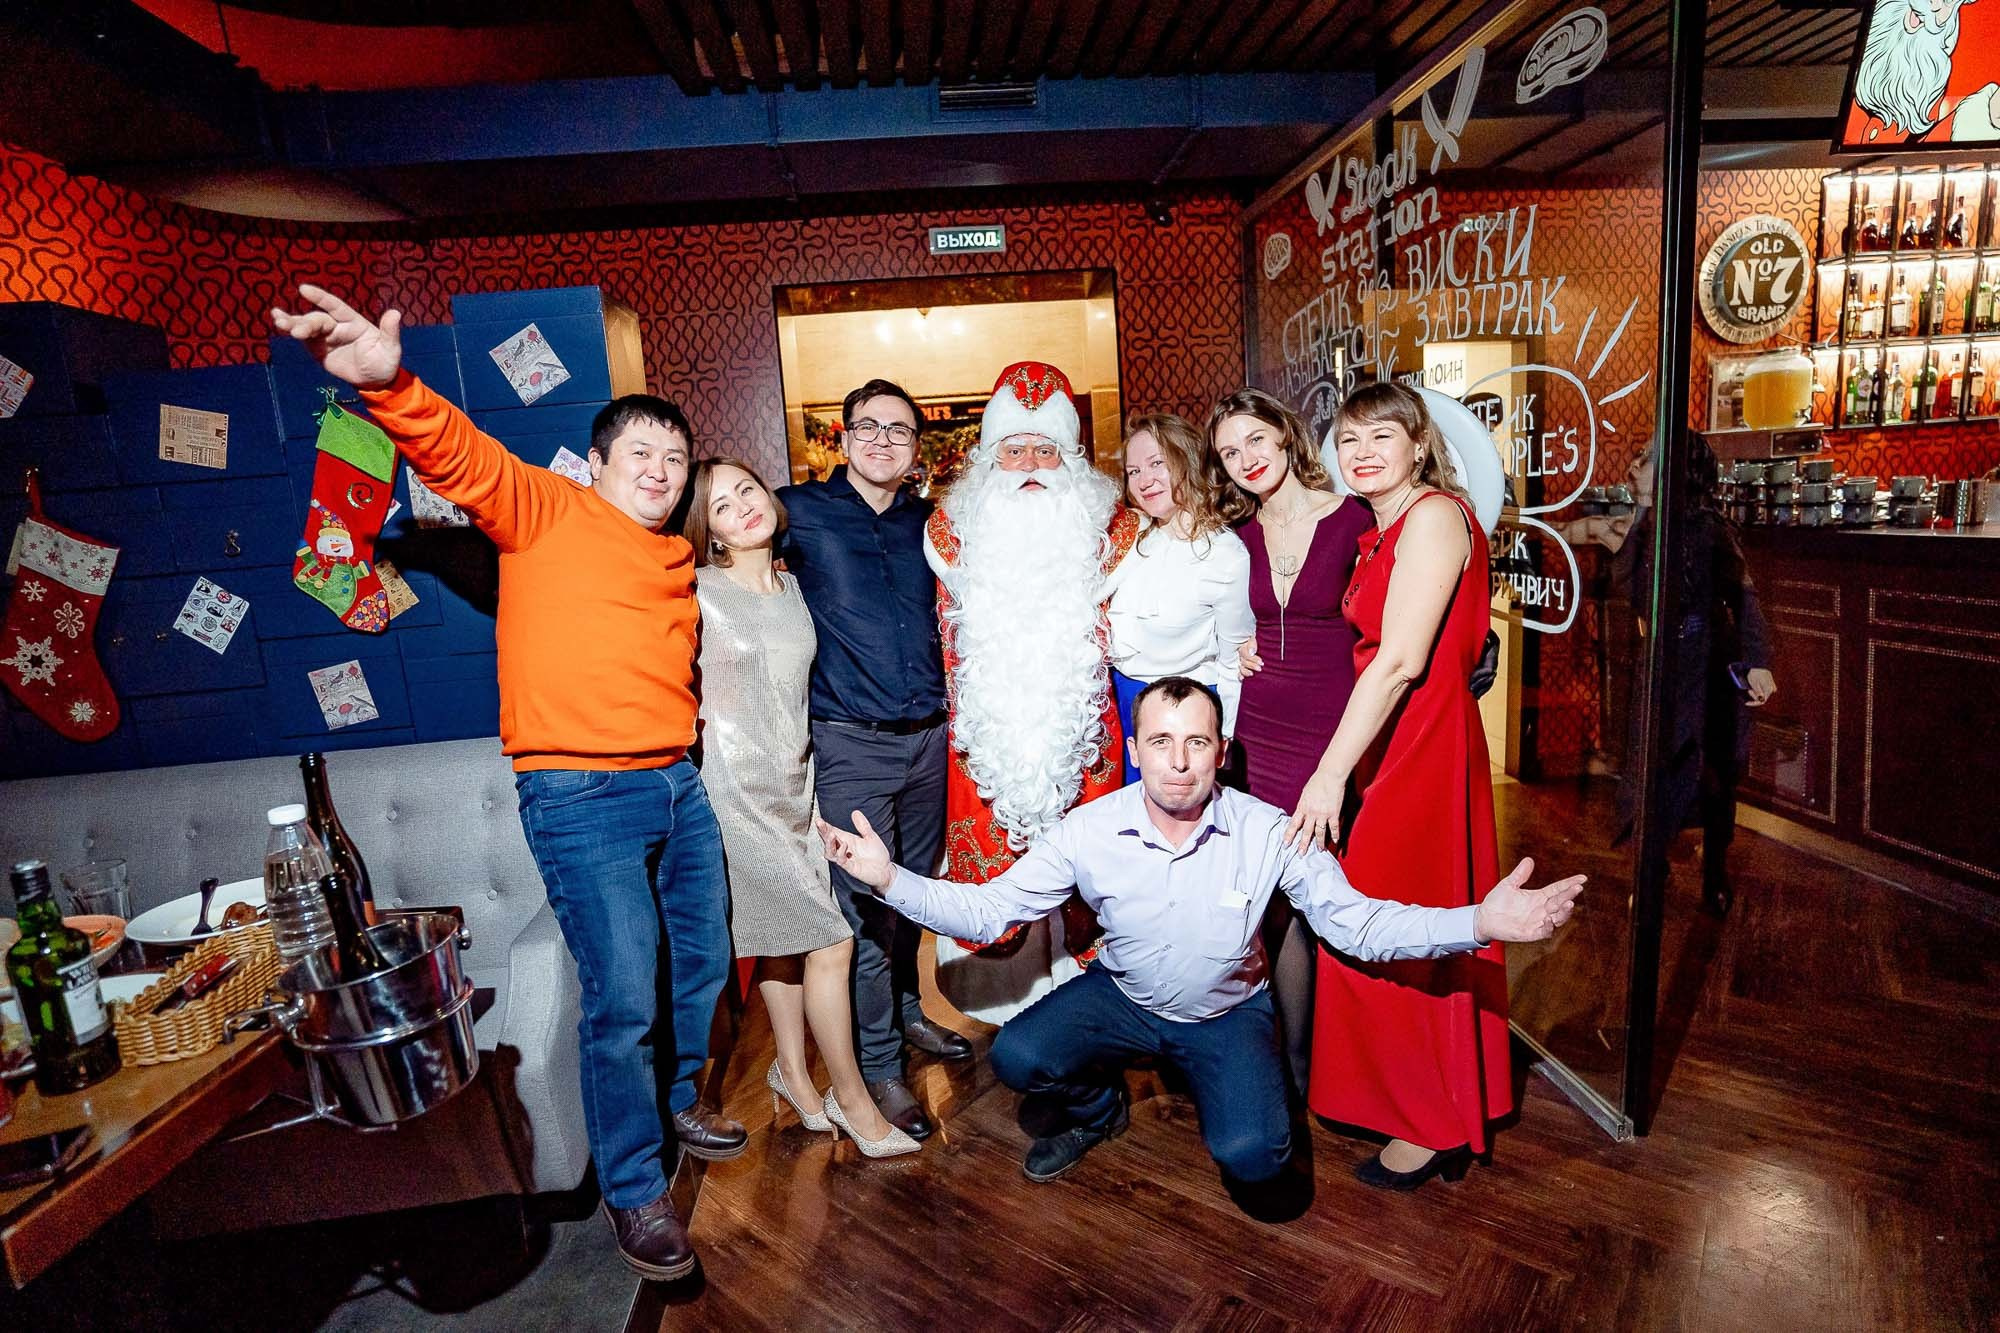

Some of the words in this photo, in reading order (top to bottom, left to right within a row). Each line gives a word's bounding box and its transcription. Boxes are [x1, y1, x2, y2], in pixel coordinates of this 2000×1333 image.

[1341, 125, 1417, 223] Steak
[936, 231, 1000, 248] ВЫХОД
[1321, 186, 1441, 283] station
[1404, 204, 1538, 304] ВИСКИ
[1750, 237, 1785, 255] OLD
[1415, 275, 1567, 347] ЗАВТРАК
[1737, 305, 1786, 323] BRAND
[1503, 425, 1579, 478] OPLE'S
[1491, 572, 1566, 611] РИНВИЧ
